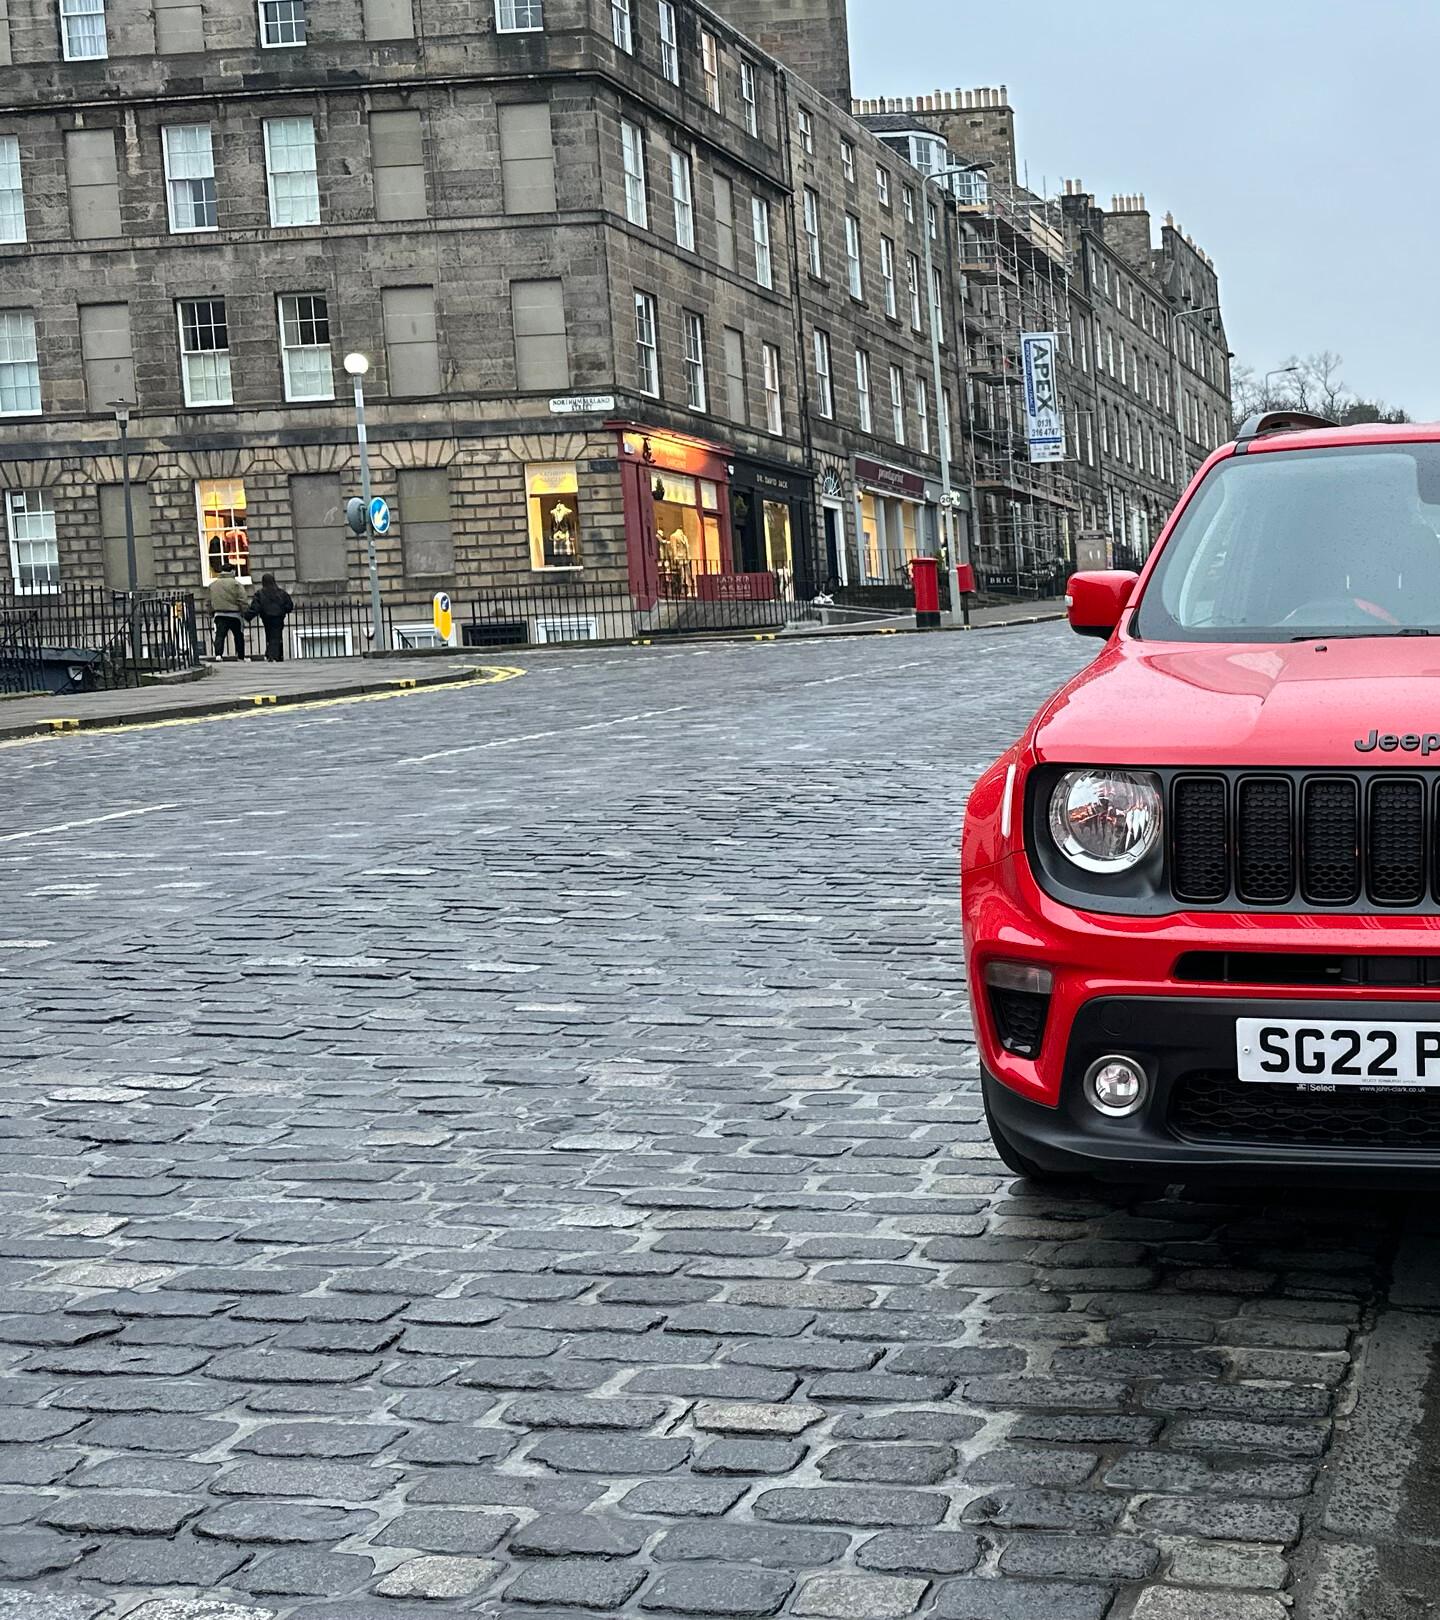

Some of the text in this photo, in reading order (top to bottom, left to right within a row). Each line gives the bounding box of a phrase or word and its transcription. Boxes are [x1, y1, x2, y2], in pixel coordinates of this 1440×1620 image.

[1033, 343, 1054, 413] APEX
[552, 398, 610, 406] NORTHUMBERLAND
[1037, 419, 1052, 428] 0131
[1043, 427, 1059, 436] 4747
[1258, 1026, 1398, 1076] SG22
[1310, 1084, 1336, 1092] Select
